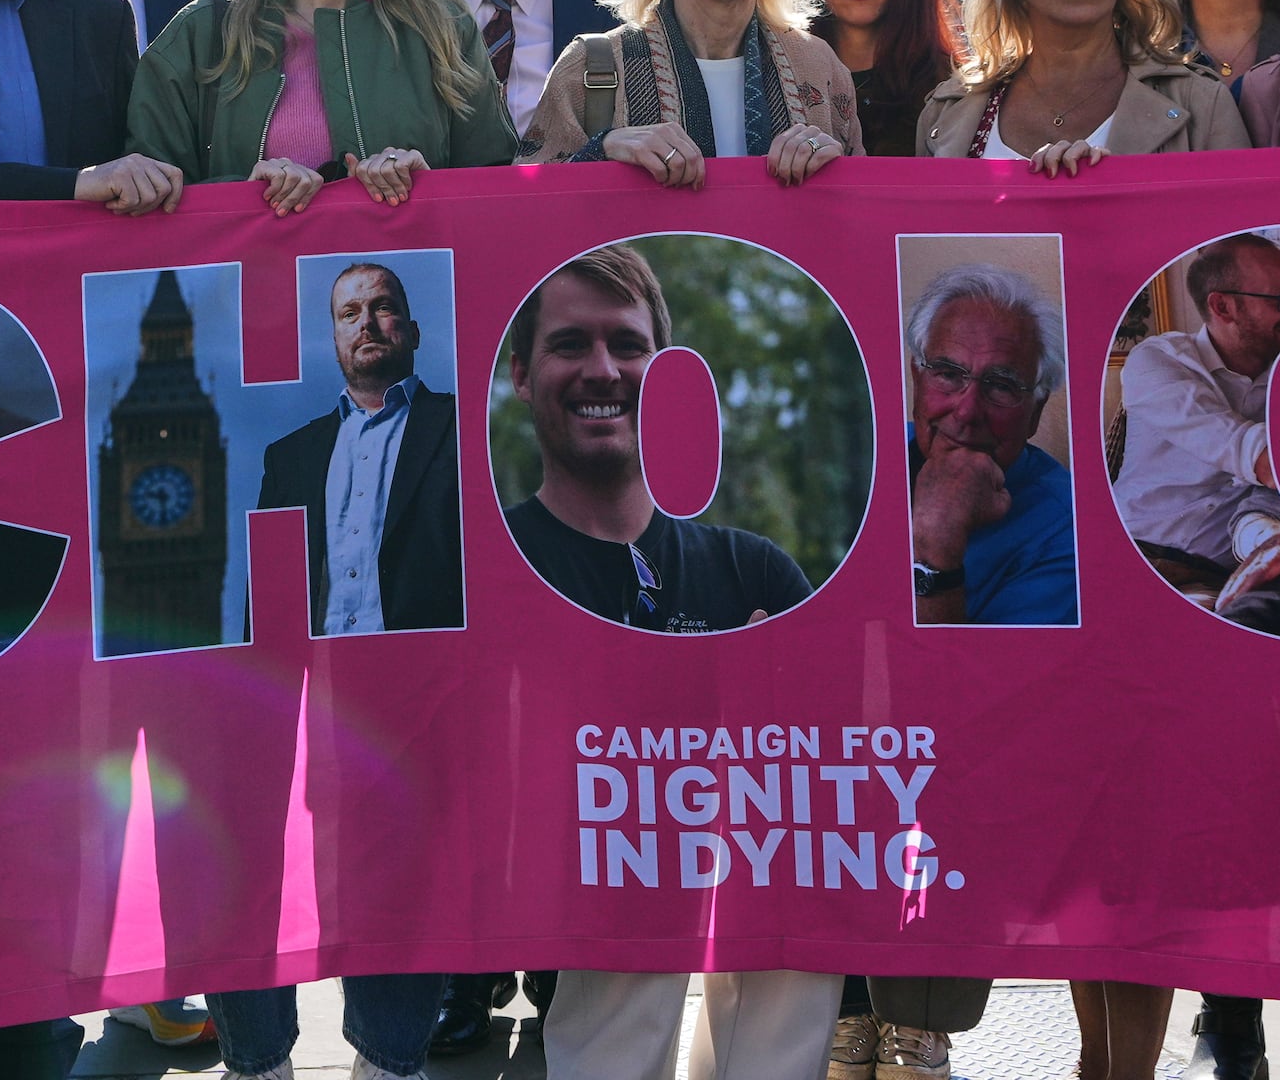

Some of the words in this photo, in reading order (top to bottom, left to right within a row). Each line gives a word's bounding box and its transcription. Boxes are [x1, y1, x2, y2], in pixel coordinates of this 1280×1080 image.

[575, 723, 821, 761] CAMPAIGN
[841, 725, 937, 760] FOR
[576, 762, 937, 826] DIGNITY
[578, 826, 660, 889] IN
[678, 827, 966, 891] DYING.
